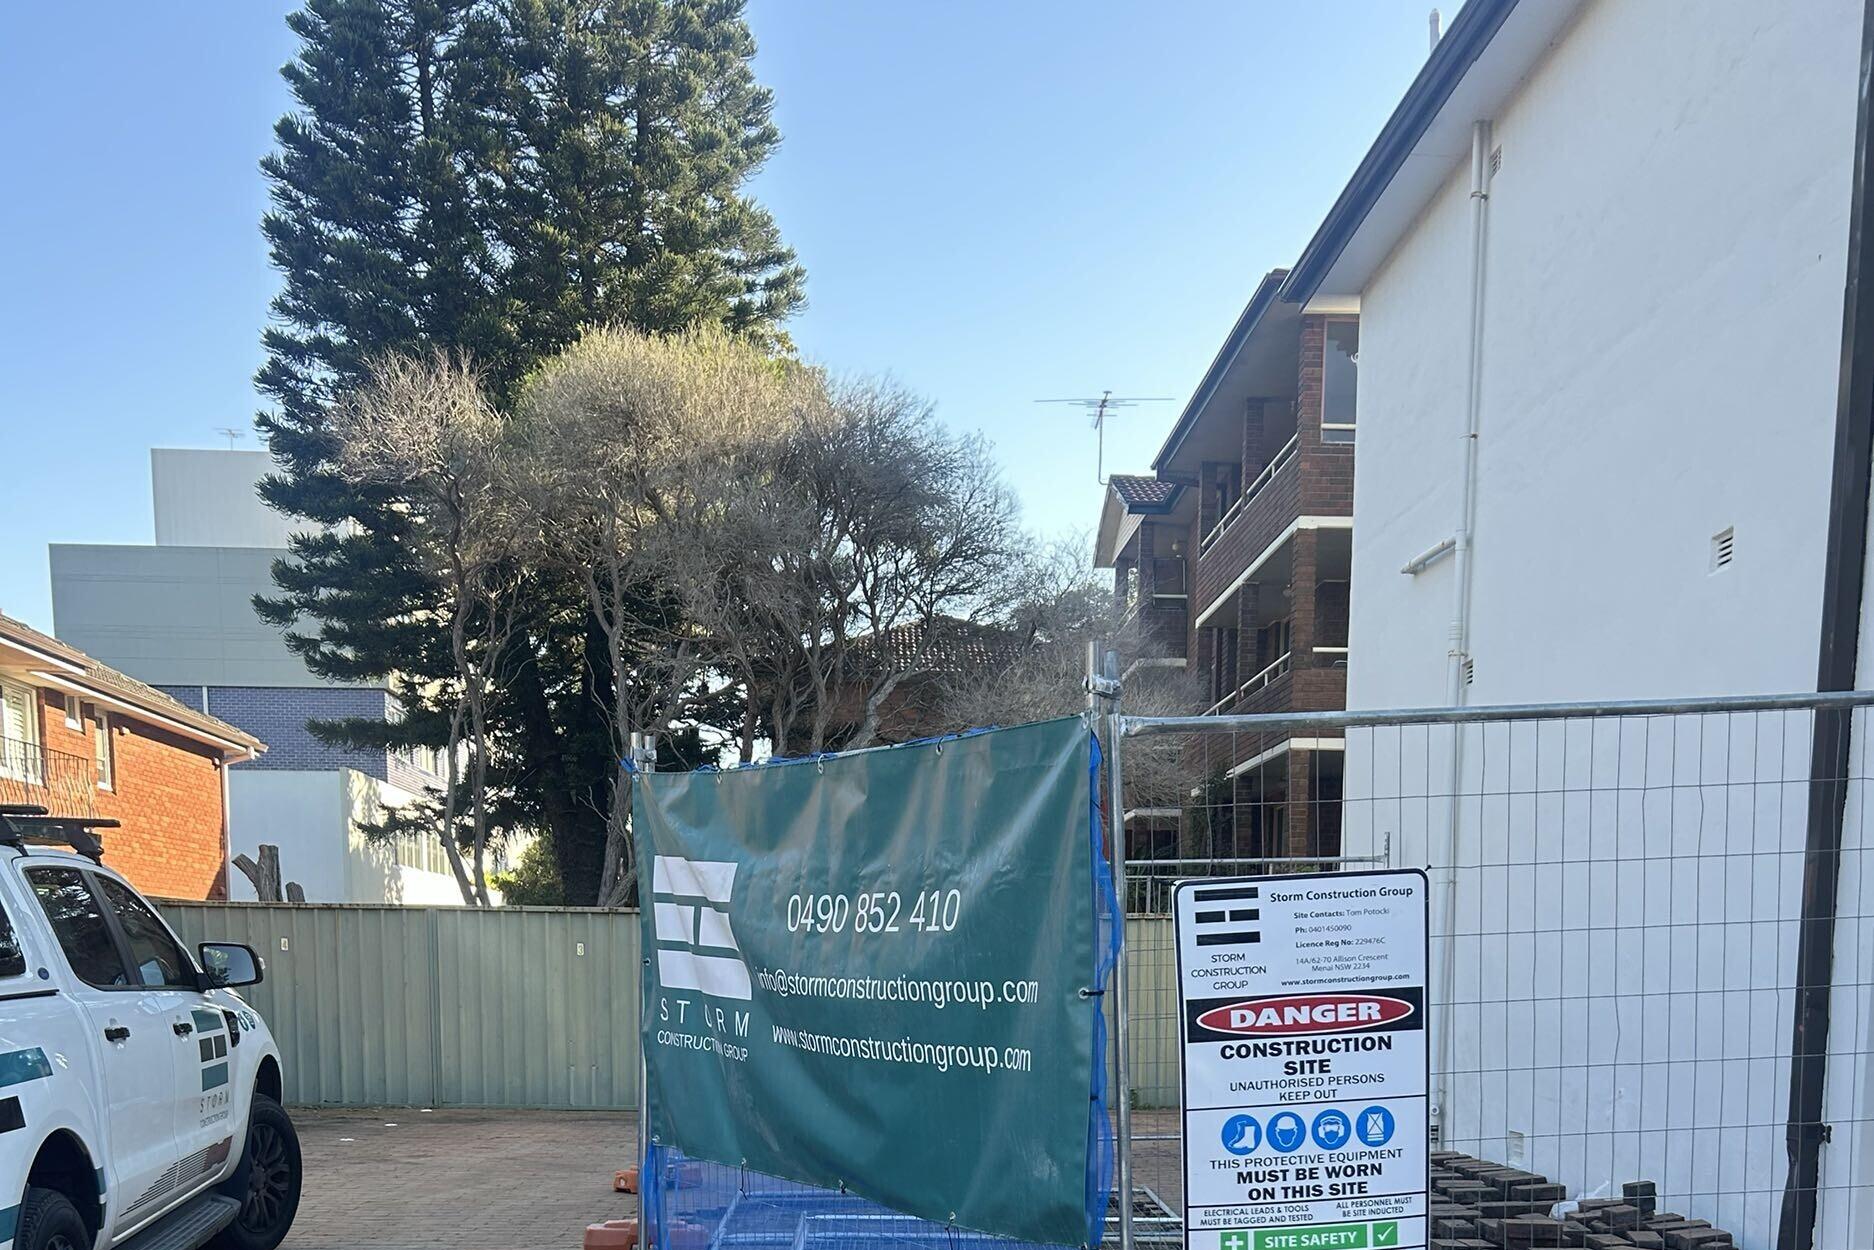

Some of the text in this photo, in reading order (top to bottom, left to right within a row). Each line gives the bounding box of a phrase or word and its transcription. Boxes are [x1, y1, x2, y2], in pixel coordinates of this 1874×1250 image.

[1270, 886, 1413, 902] Storm Construction Group
[786, 888, 961, 933] 0490 852 410
[1294, 911, 1308, 919] Site
[1310, 910, 1345, 919] Contacts:
[1346, 909, 1362, 917] Tom
[1296, 940, 1324, 948] Licence
[1211, 953, 1246, 963] STORM
[1358, 953, 1389, 962] Crescent
[1190, 965, 1267, 978] CONSTRUCTION
[1335, 963, 1352, 971] NSW
[1212, 980, 1249, 990] GROUP
[1280, 973, 1410, 986] www.stormconstructiongroup.com
[755, 966, 1039, 1012] nfo@stormconstructiongroup.com
[1230, 1002, 1382, 1029] DANGER
[772, 1024, 1032, 1074] www.stormconstructiongroup.com
[1220, 1034, 1392, 1060] CONSTRUCTION
[1283, 1058, 1331, 1075] SITE
[1230, 1073, 1385, 1092] UNAUTHORISED PERSONS
[1279, 1089, 1337, 1101] KEEP OUT
[1210, 1148, 1403, 1170] THIS PROTECTIVE EQUIPMENT
[1237, 1162, 1382, 1185] MUST BE WORN
[1248, 1181, 1368, 1201] ON THIS SITE
[1336, 1197, 1413, 1209] ALL PERSONNEL MUST
[1204, 1205, 1309, 1217] ELECTRICAL LEADS & TOOLS
[1342, 1206, 1404, 1218] BE SITE INDUCTED
[1200, 1213, 1314, 1226] MUST BE TAGGED AND TESTED
[1264, 1231, 1357, 1249] SITE SAFETY
